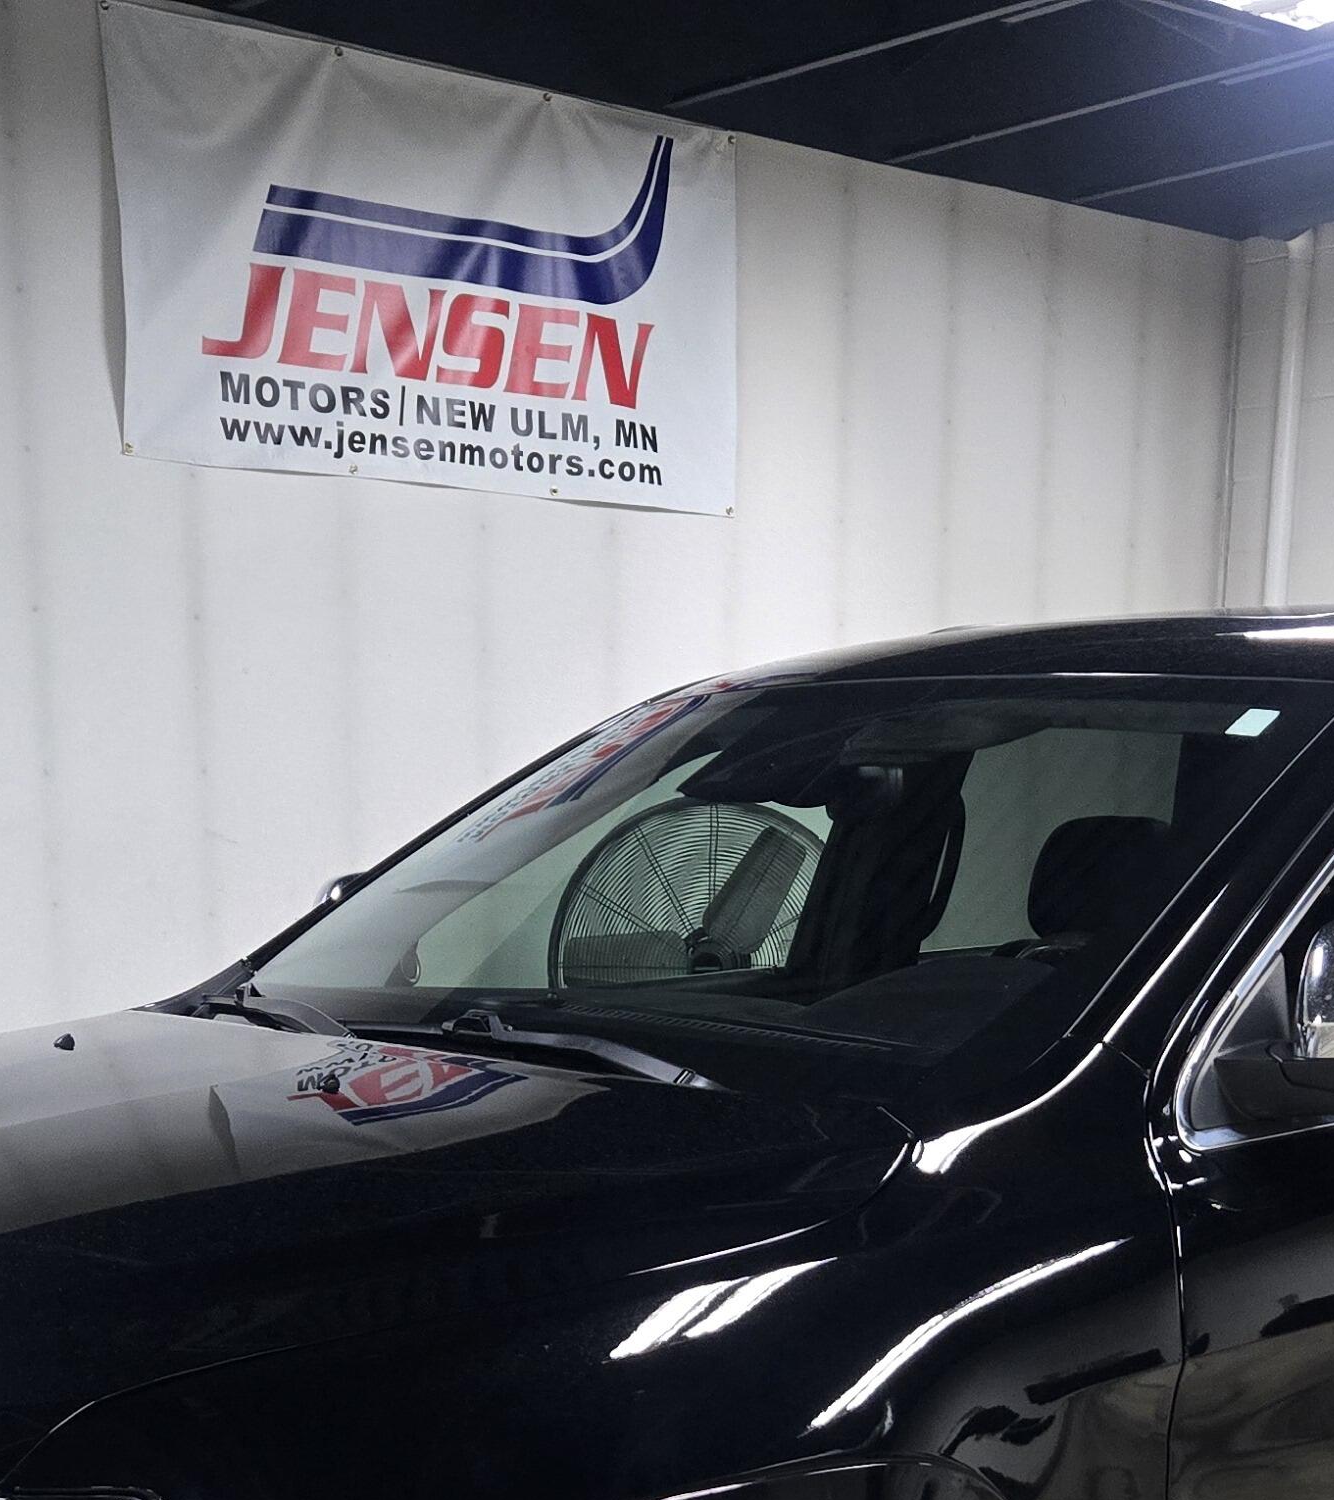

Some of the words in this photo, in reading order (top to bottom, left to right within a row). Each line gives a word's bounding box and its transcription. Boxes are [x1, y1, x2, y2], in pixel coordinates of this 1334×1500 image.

[202, 262, 655, 410] JENSEN
[219, 370, 391, 420] MOTORS
[416, 394, 496, 432] NEW
[510, 407, 601, 451] ULM,
[615, 418, 658, 453] MN
[219, 416, 663, 485] www.jensenmotors.com
